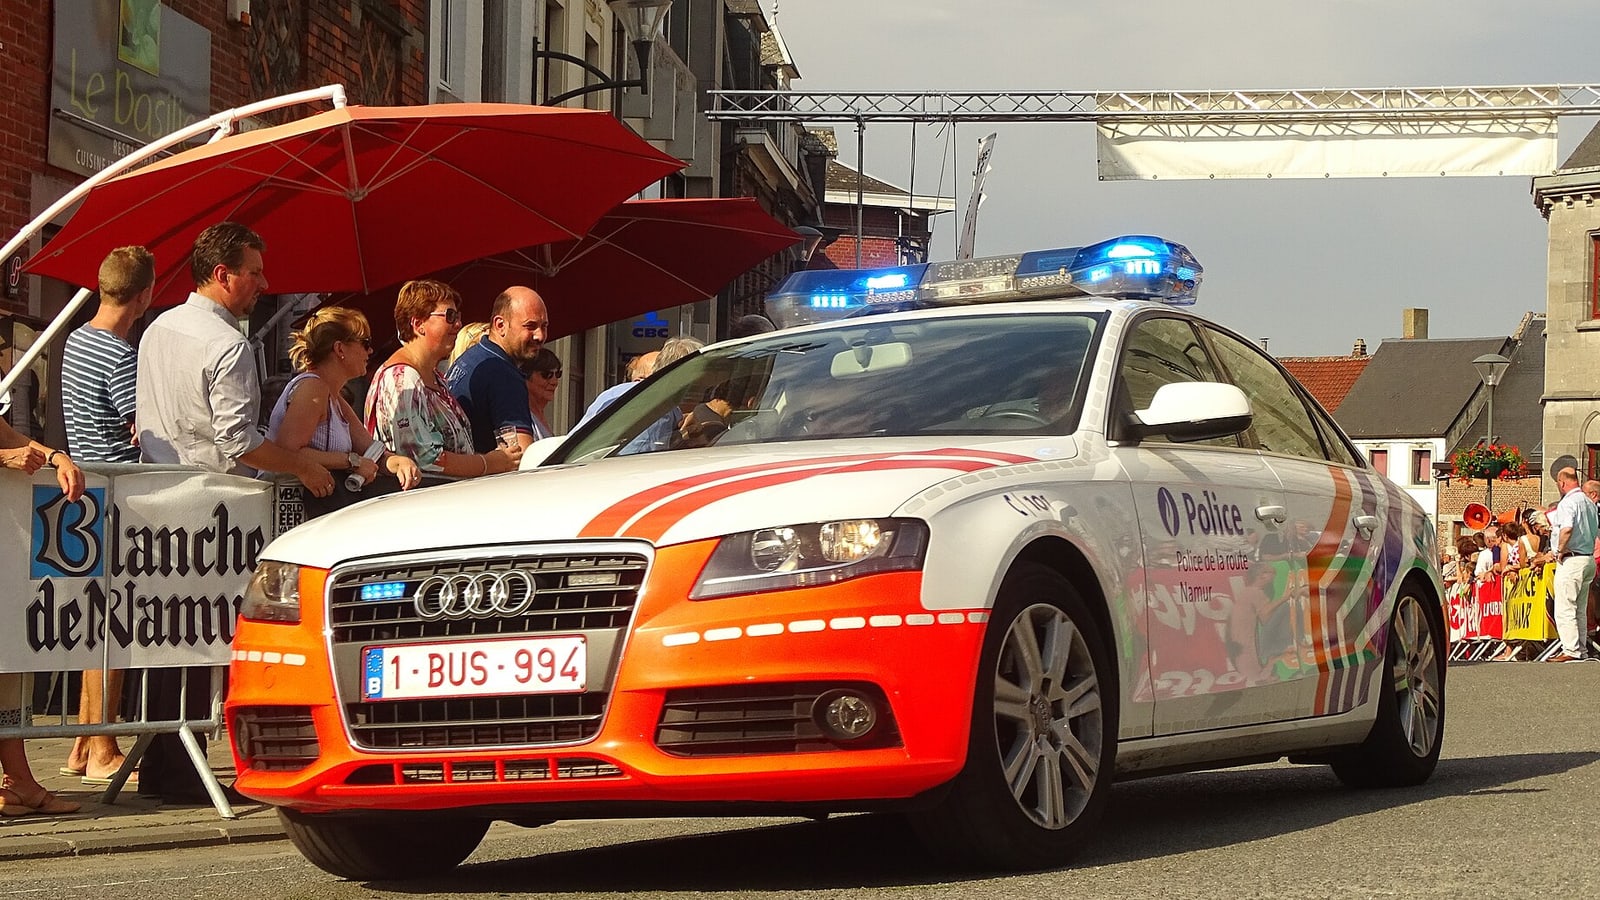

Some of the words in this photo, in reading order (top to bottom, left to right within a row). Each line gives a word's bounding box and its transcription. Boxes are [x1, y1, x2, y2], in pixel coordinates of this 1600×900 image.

[71, 48, 105, 119] Le
[631, 327, 669, 338] CBC
[280, 503, 304, 512] ORLD
[1181, 490, 1244, 536] Police
[280, 512, 302, 526] EER
[1176, 549, 1204, 572] Police
[1204, 549, 1216, 571] de
[1216, 548, 1225, 570] la
[1225, 549, 1249, 570] route
[1180, 581, 1213, 603] Namur
[84, 578, 244, 649] Namu
[367, 677, 382, 694] B
